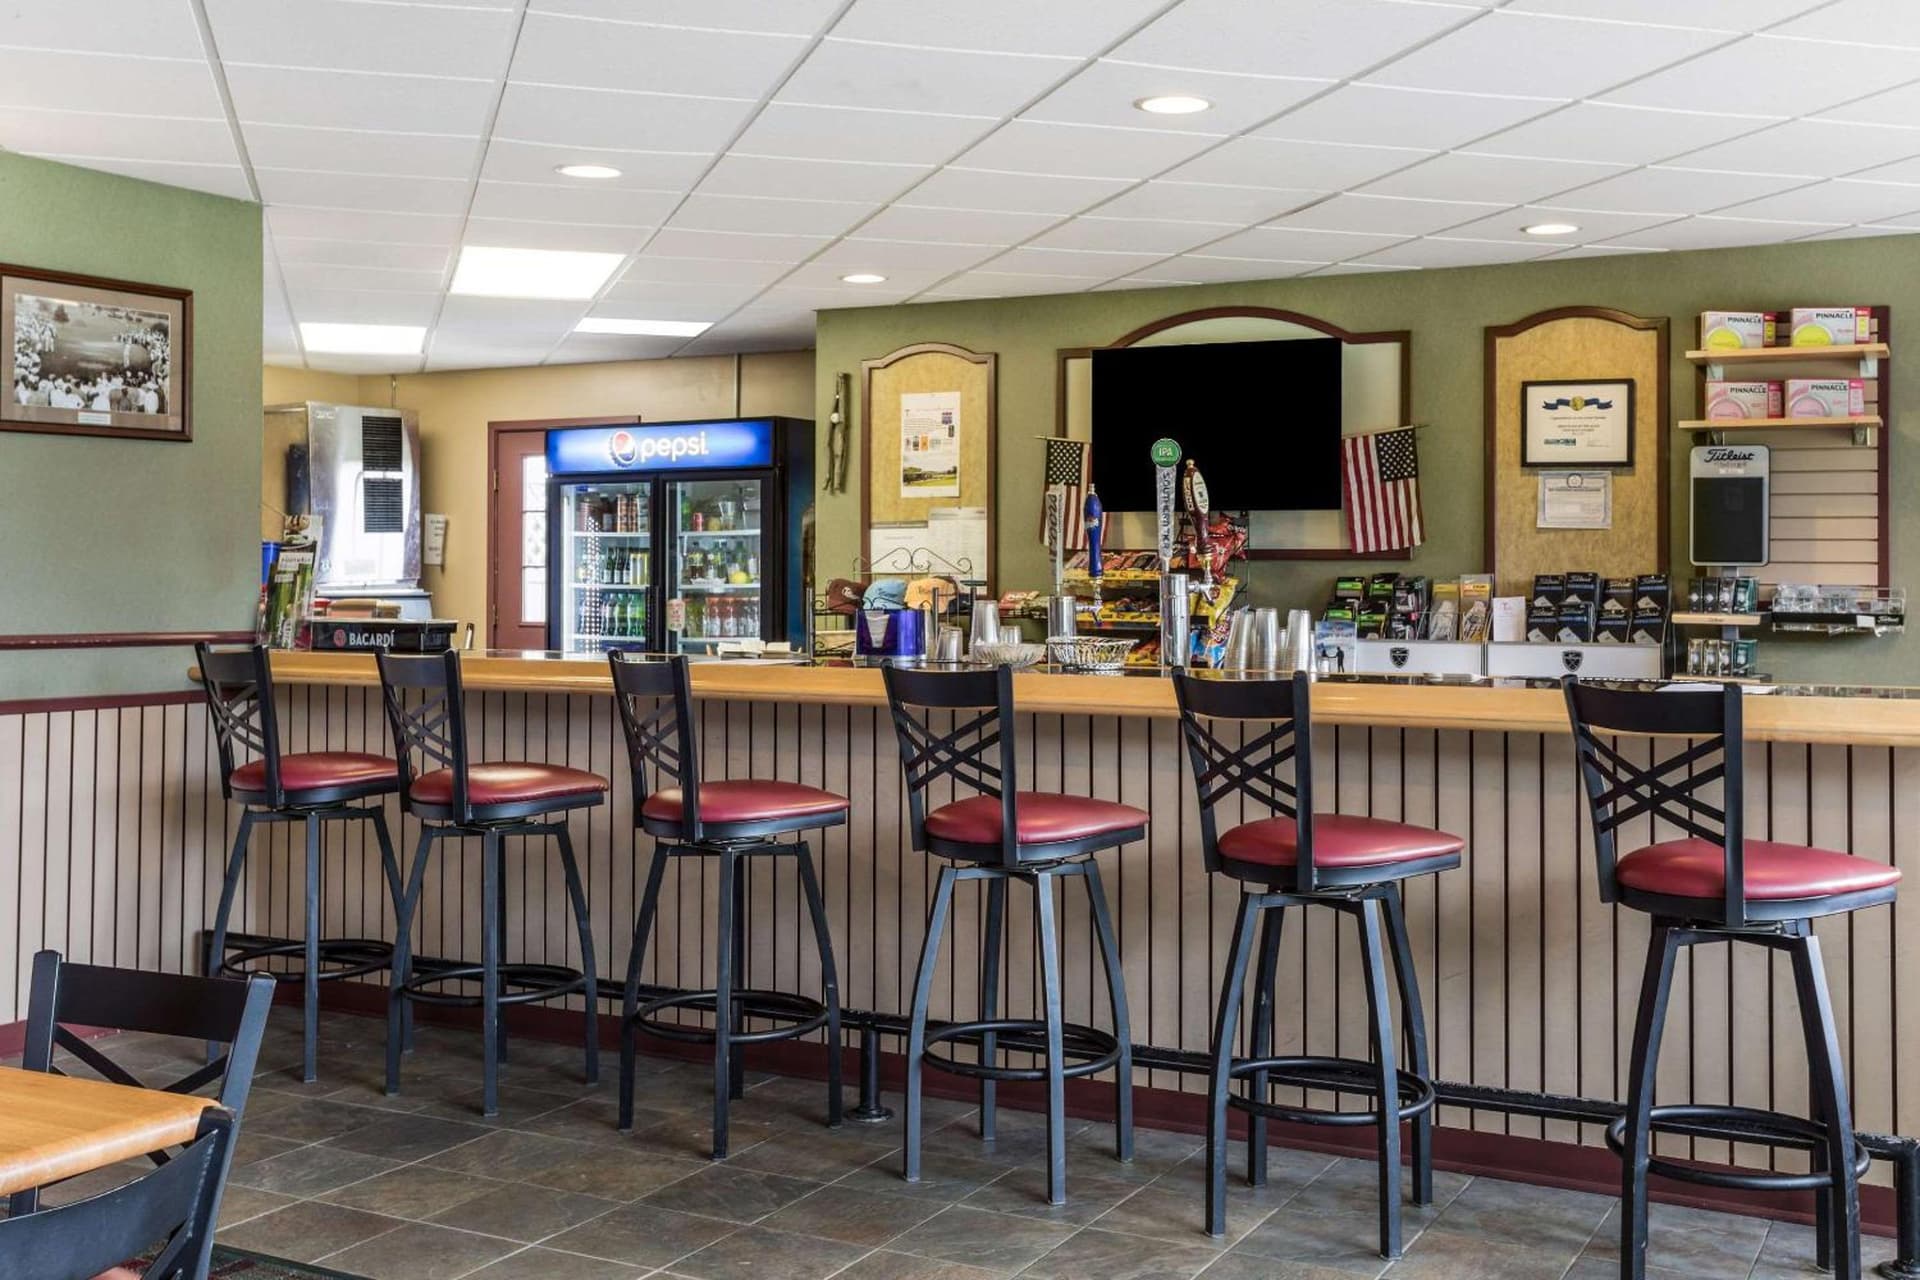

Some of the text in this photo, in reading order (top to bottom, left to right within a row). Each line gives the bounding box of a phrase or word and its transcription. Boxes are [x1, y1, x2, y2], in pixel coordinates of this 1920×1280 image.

[1727, 316, 1761, 324] PINNACLE
[641, 431, 706, 463] pepsi
[1159, 447, 1172, 456] IPA
[1704, 448, 1755, 463] Titleist
